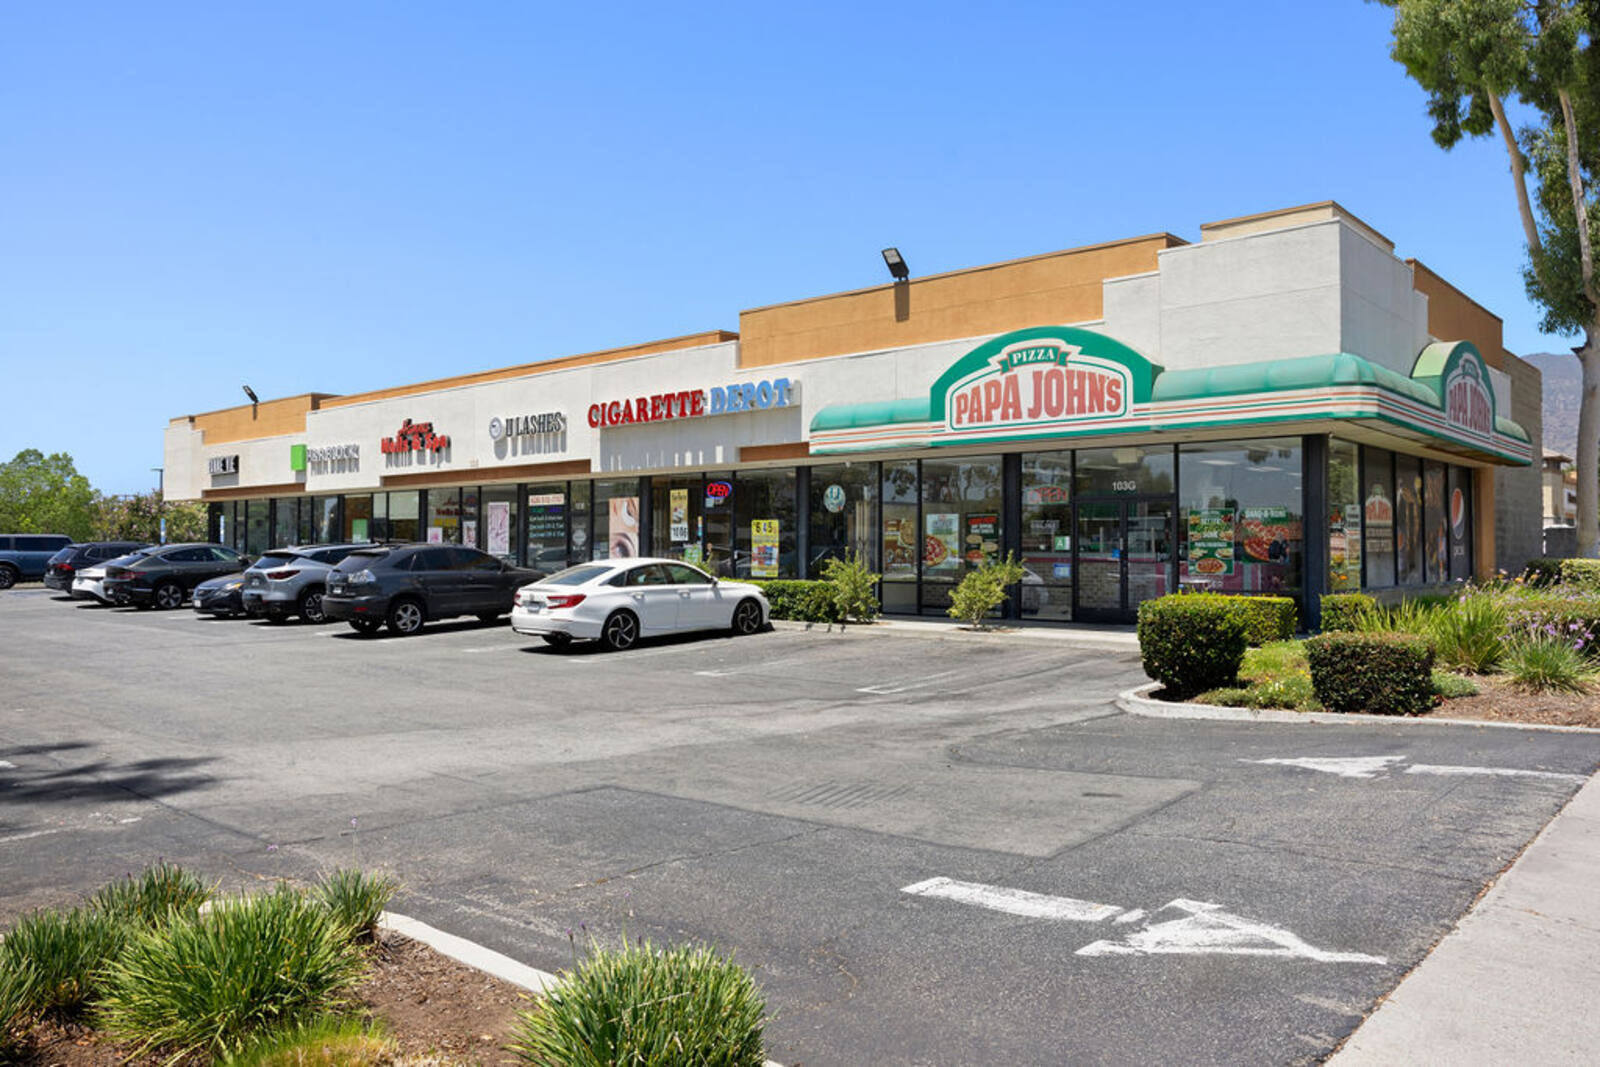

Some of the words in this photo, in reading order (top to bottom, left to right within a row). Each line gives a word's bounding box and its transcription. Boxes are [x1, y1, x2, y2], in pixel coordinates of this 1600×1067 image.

[1012, 348, 1055, 364] PIZZA
[588, 389, 704, 428] CIGARETTE
[710, 378, 790, 414] DEPOT
[955, 374, 1022, 425] PAPA
[1027, 368, 1121, 418] JOHN'S
[516, 412, 562, 436] LASHES
[381, 435, 408, 454] Nails
[425, 432, 447, 453] Spa
[707, 483, 730, 497] OPEN
[1028, 487, 1067, 502] OPEN
[1112, 481, 1136, 491] 103G
